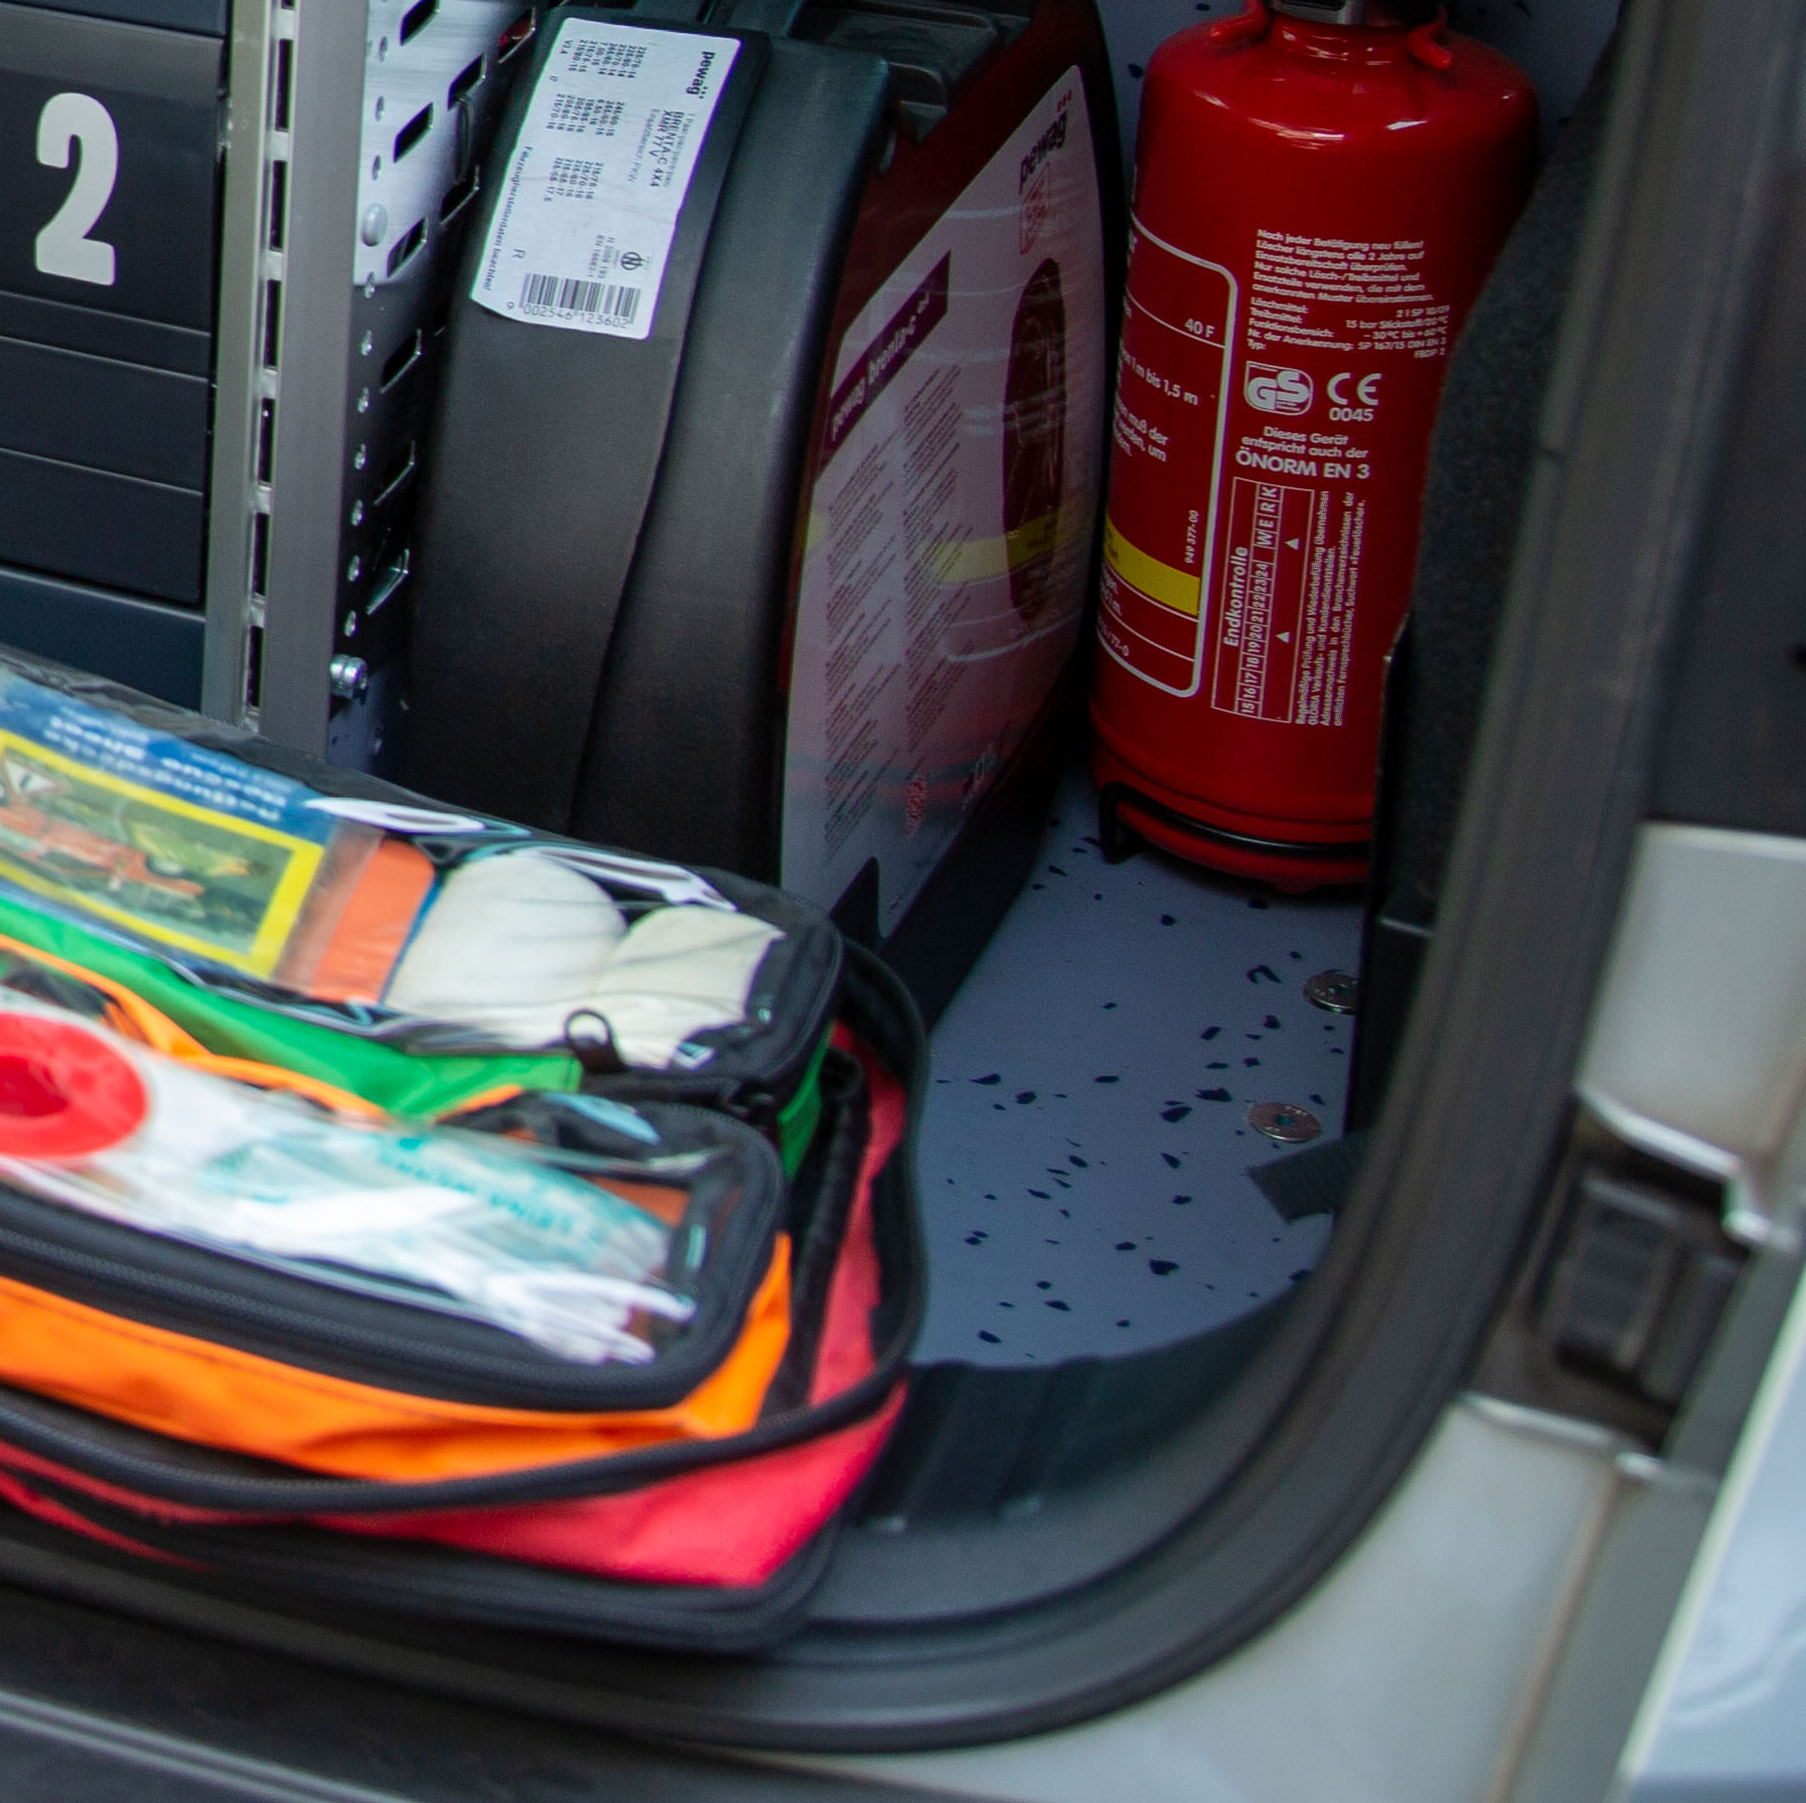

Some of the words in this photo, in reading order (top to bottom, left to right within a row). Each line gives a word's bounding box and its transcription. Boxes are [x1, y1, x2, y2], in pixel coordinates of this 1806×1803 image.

[686, 51, 716, 96] pewag
[1019, 109, 1067, 195] pewag
[35, 93, 118, 287] 2
[1285, 234, 1312, 245] jeder
[511, 249, 526, 259] R
[1346, 251, 1366, 260] alle
[1368, 252, 1375, 260] 2
[1377, 252, 1406, 261] Jahre
[1407, 250, 1425, 260] auf
[1254, 261, 1273, 271] Nur
[1274, 266, 1307, 277] solche
[1400, 272, 1421, 282] und
[1317, 292, 1354, 302] Muster
[1366, 284, 1383, 293] die
[1385, 284, 1402, 293] mit
[1403, 283, 1426, 292] dem
[1250, 296, 1308, 314] Löschmittel:
[507, 301, 515, 310] 9
[523, 303, 574, 321] 002546
[580, 312, 629, 329] 123602
[1249, 306, 1303, 324] Treibmittel:
[1359, 320, 1377, 329] bar
[1184, 317, 1204, 335] 40
[1205, 324, 1216, 338] F
[1248, 317, 1335, 338] Funktionsbereich:
[1401, 329, 1416, 339] bis
[1263, 332, 1281, 342] der
[1282, 335, 1355, 352] Anerkennung:
[1146, 367, 1162, 389] bis
[1163, 379, 1182, 398] 1,5
[1183, 391, 1199, 406] m
[1247, 369, 1310, 411] GS
[1327, 371, 1383, 406] CE
[1328, 407, 1375, 423] 0045
[1148, 426, 1170, 446] der
[1263, 425, 1308, 443] Dieses
[1309, 432, 1350, 446] Gerät
[1148, 444, 1168, 463] um
[1241, 435, 1306, 455] entspricht
[1307, 447, 1342, 459] auch
[1344, 447, 1370, 459] der
[1235, 446, 1318, 478] ÖNORM
[1322, 462, 1353, 480] EN
[1356, 463, 1372, 481] 3
[1342, 492, 1354, 507] der
[1314, 491, 1330, 545] übernehmen
[1255, 563, 1268, 577] 24
[1253, 578, 1267, 592] 23
[1223, 546, 1248, 647] Endkontrolle
[1252, 594, 1266, 608] 22
[1250, 610, 1265, 623] 21
[1306, 617, 1316, 634] und
[1330, 616, 1341, 633] den
[1249, 625, 1263, 640] 20
[1328, 637, 1339, 645] in
[1248, 641, 1262, 653] 19
[1301, 636, 1316, 669] Prüfung
[1246, 657, 1260, 668] 18
[1245, 672, 1258, 684] 17
[1307, 695, 1320, 726] GLORIA
[1317, 634, 1327, 651] und
[1243, 688, 1257, 699] 16
[1241, 703, 1255, 714] 15
